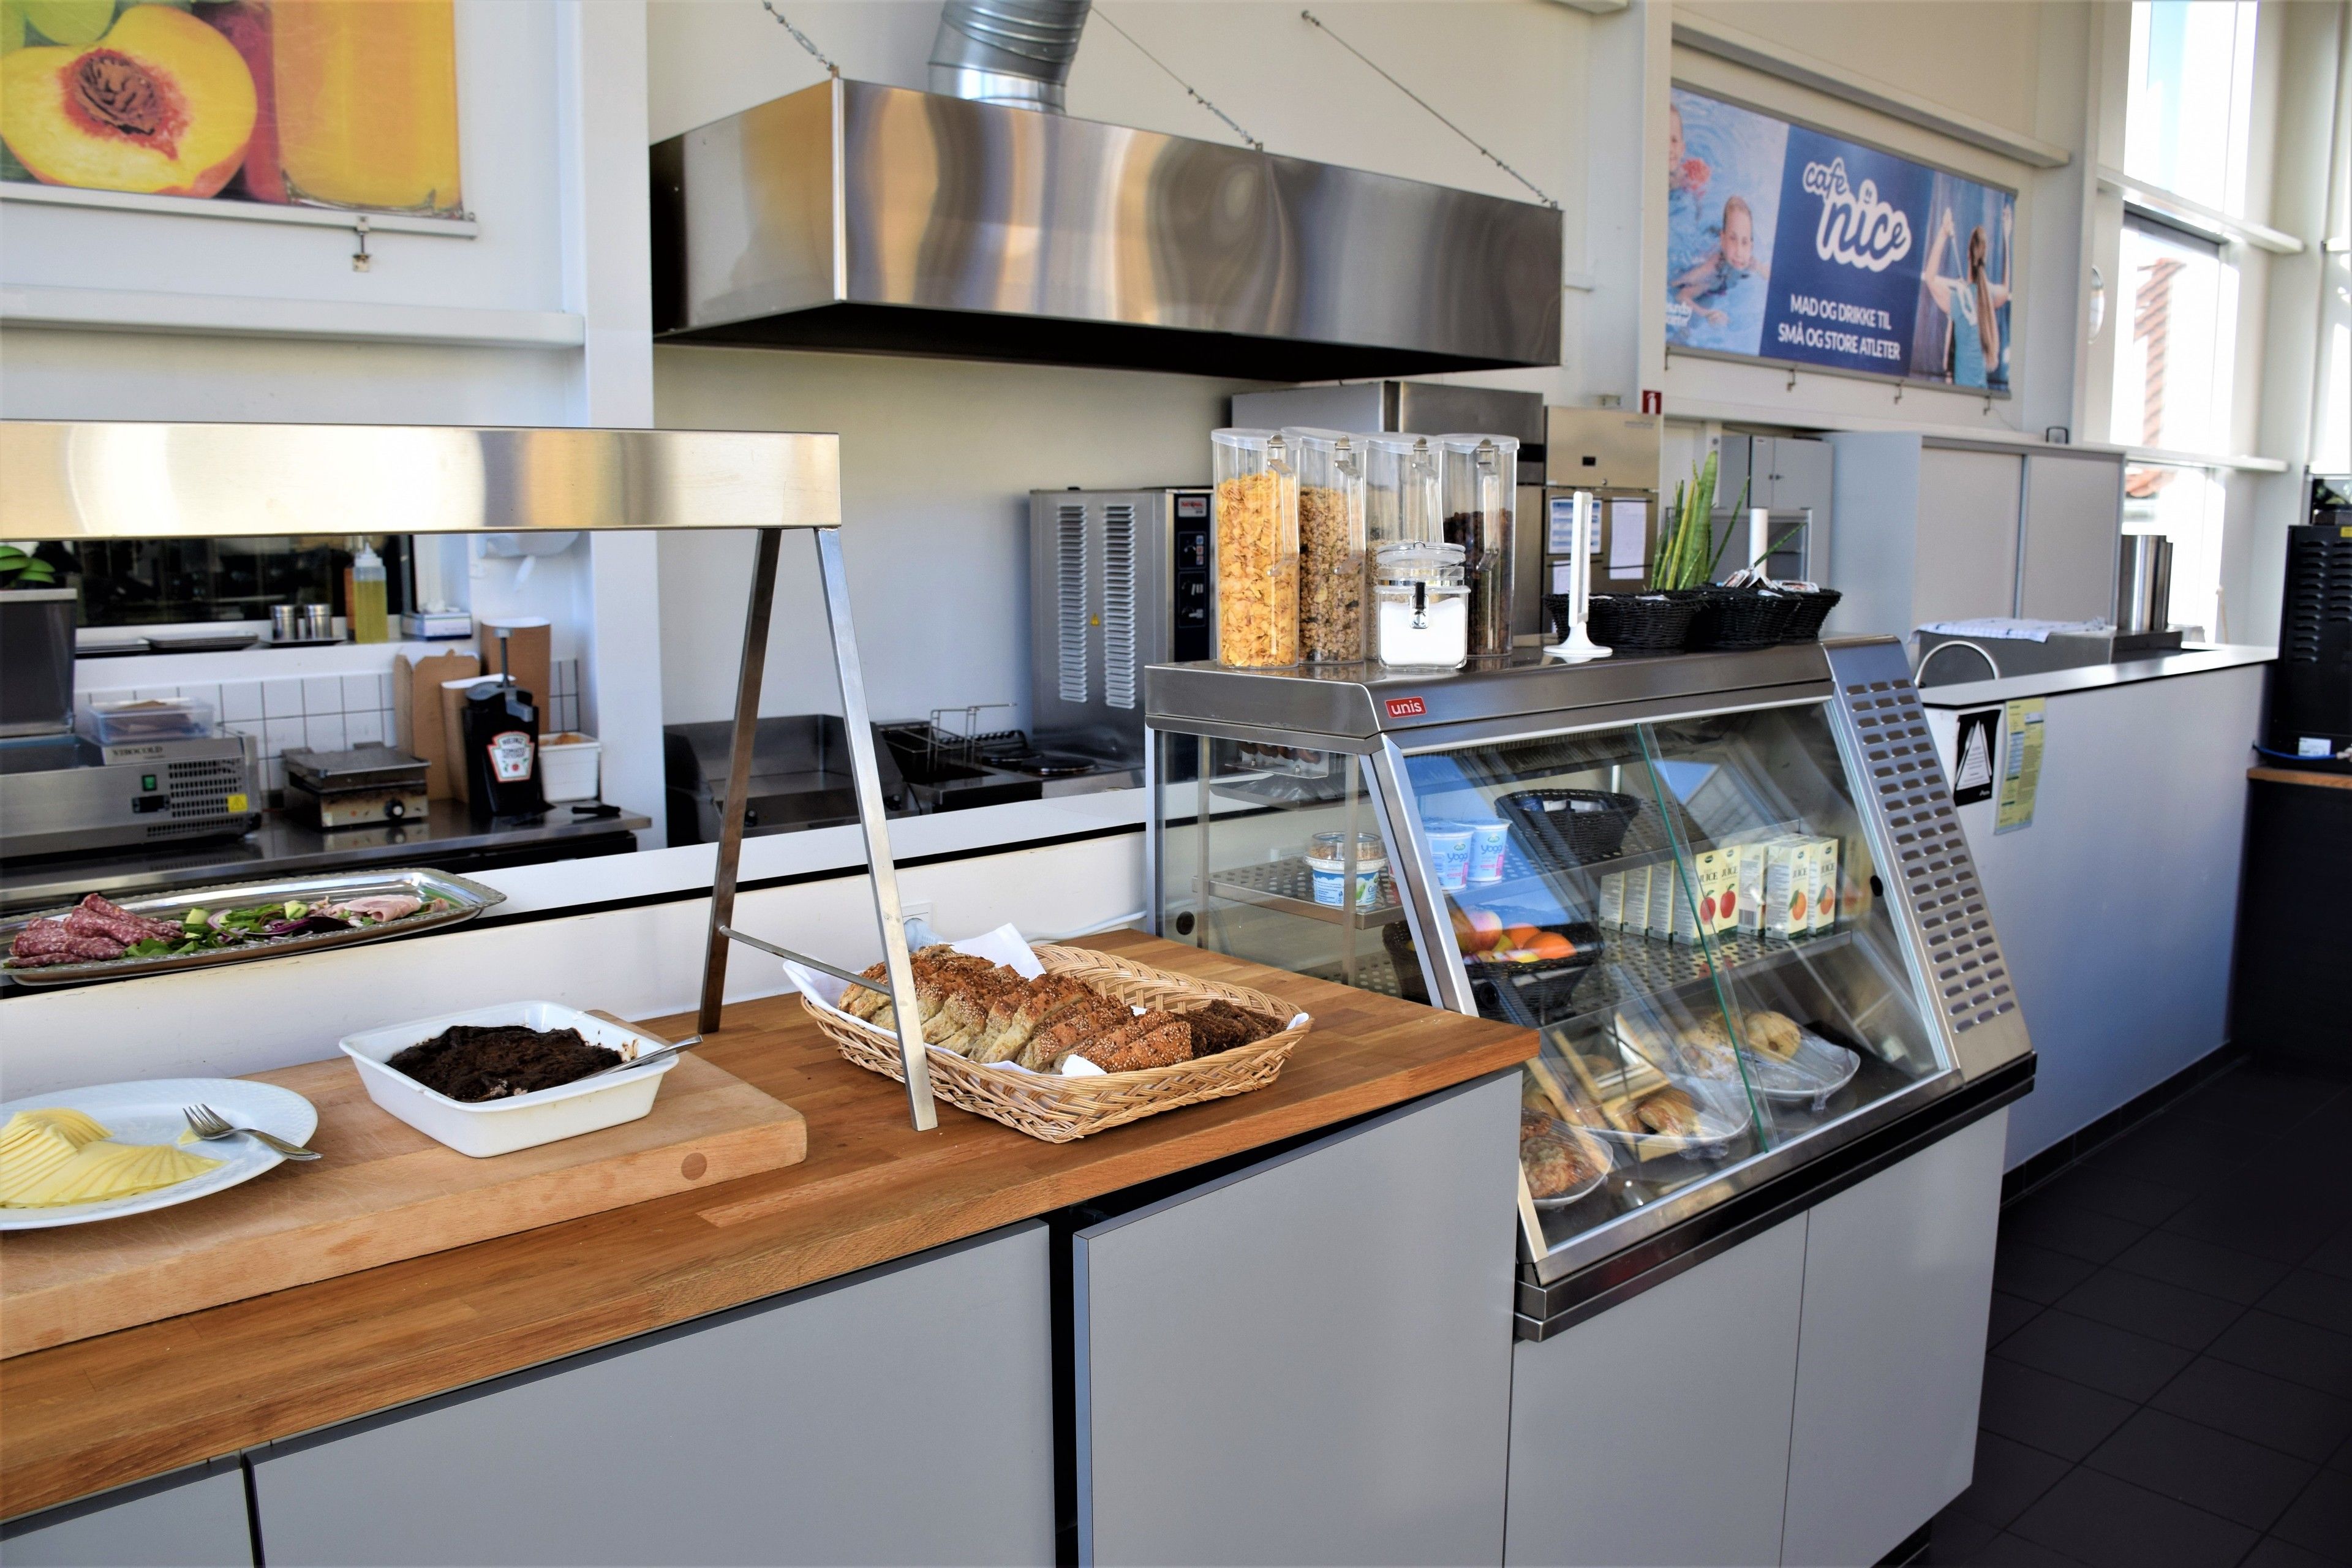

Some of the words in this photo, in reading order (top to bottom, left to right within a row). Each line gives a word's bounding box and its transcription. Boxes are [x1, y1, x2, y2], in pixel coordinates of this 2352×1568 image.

[1820, 184, 1909, 266] nice
[1790, 293, 1819, 317] MAD
[1819, 299, 1838, 320] OG
[1838, 303, 1877, 328] DRIKKE
[1877, 309, 1892, 331] TIL
[1778, 320, 1805, 345] SMÅ
[1806, 327, 1824, 349] OG
[1824, 330, 1859, 354] STORE
[1859, 336, 1901, 361] ATLETER
[1390, 700, 1422, 715] unis
[1722, 865, 1738, 878] JUICE
